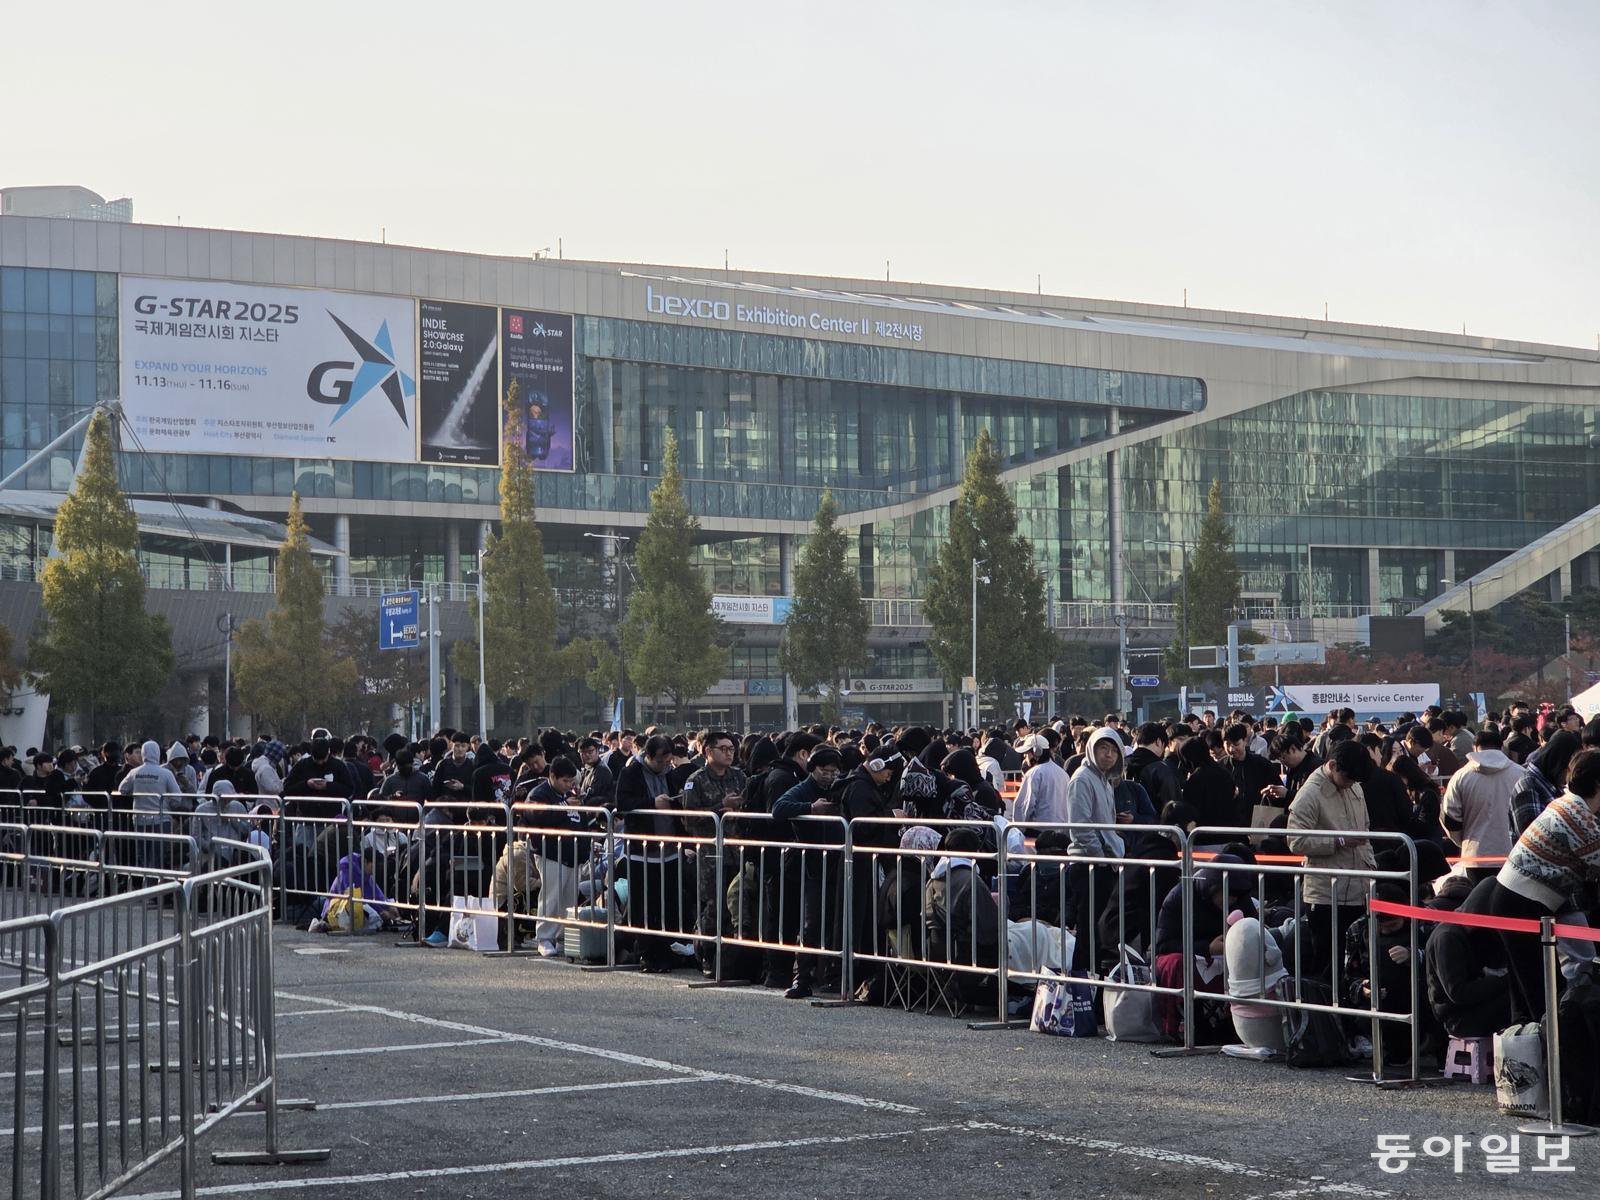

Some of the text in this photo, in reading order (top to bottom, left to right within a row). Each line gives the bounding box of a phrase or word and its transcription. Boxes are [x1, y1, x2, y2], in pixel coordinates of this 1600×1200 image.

[647, 285, 730, 321] bexco
[736, 304, 806, 329] Exhibition
[809, 313, 858, 335] Center
[875, 321, 922, 341] 제2전시장
[134, 319, 279, 343] 국제게임전시회 지스타
[422, 317, 447, 331] INDIE
[423, 330, 465, 342] SHOWCASE
[134, 360, 268, 376] EXPAND YOUR HORIZONS
[751, 603, 769, 613] 지스타
[1312, 692, 1424, 704] 종합안내소 Service Center
